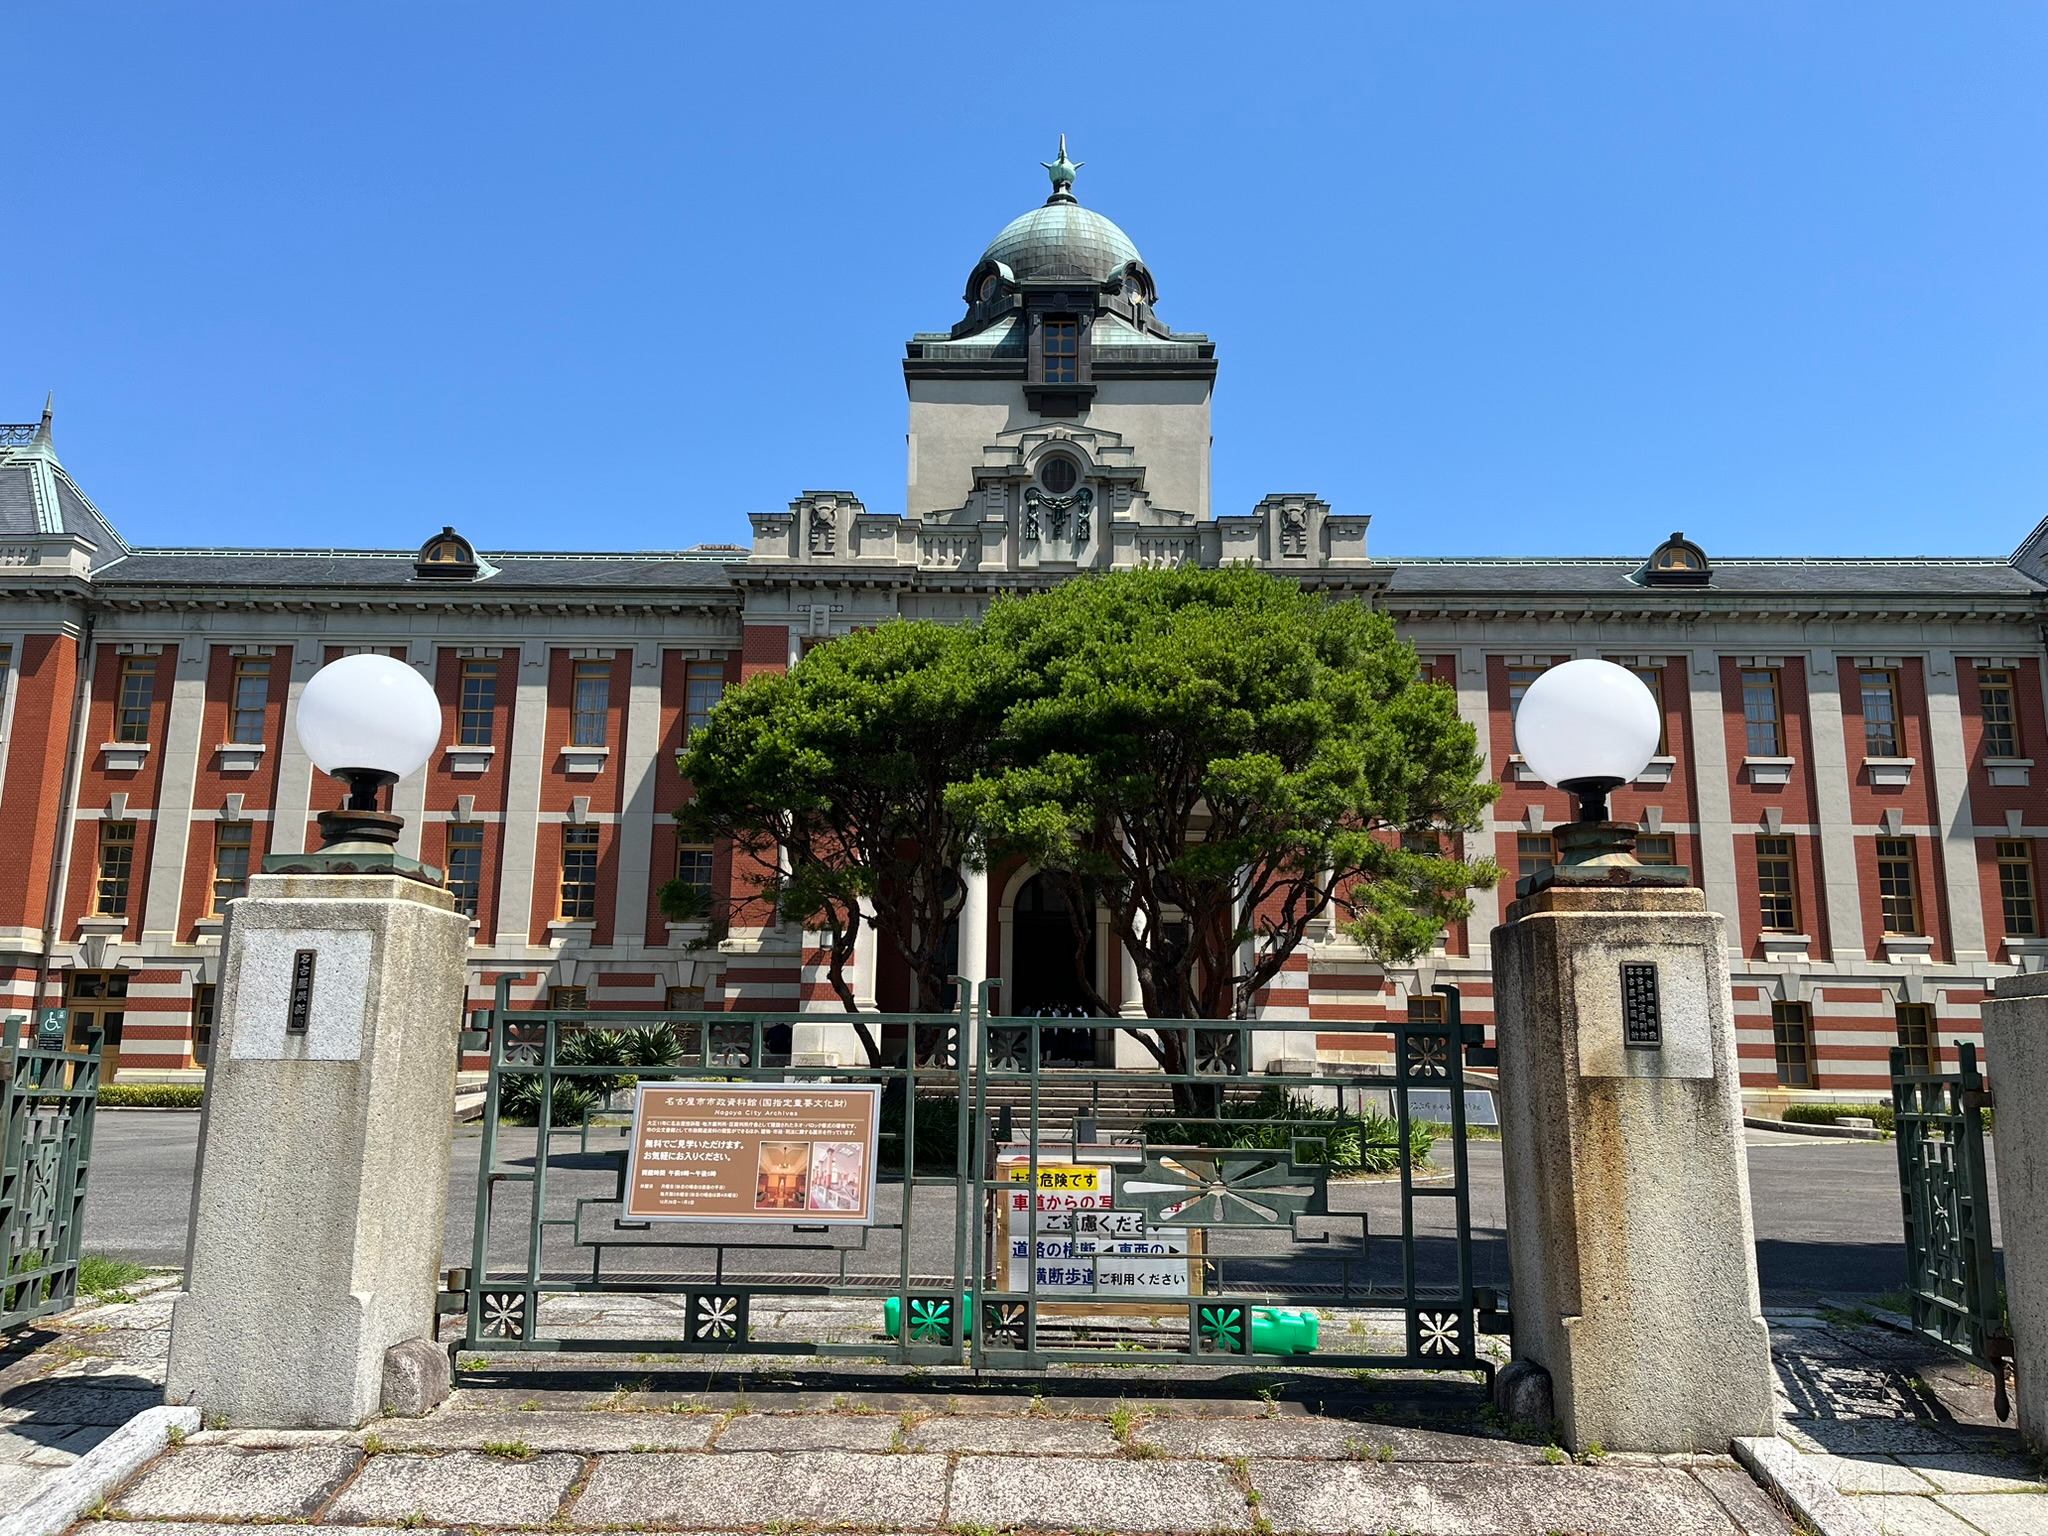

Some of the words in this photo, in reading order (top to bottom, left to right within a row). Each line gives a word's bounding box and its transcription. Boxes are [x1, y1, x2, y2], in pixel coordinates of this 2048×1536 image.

[644, 1140, 745, 1150] 無料でご見学いただけます。
[643, 1152, 731, 1161] お気軽にお入りください。
[1099, 1273, 1185, 1285] ご利用ください
